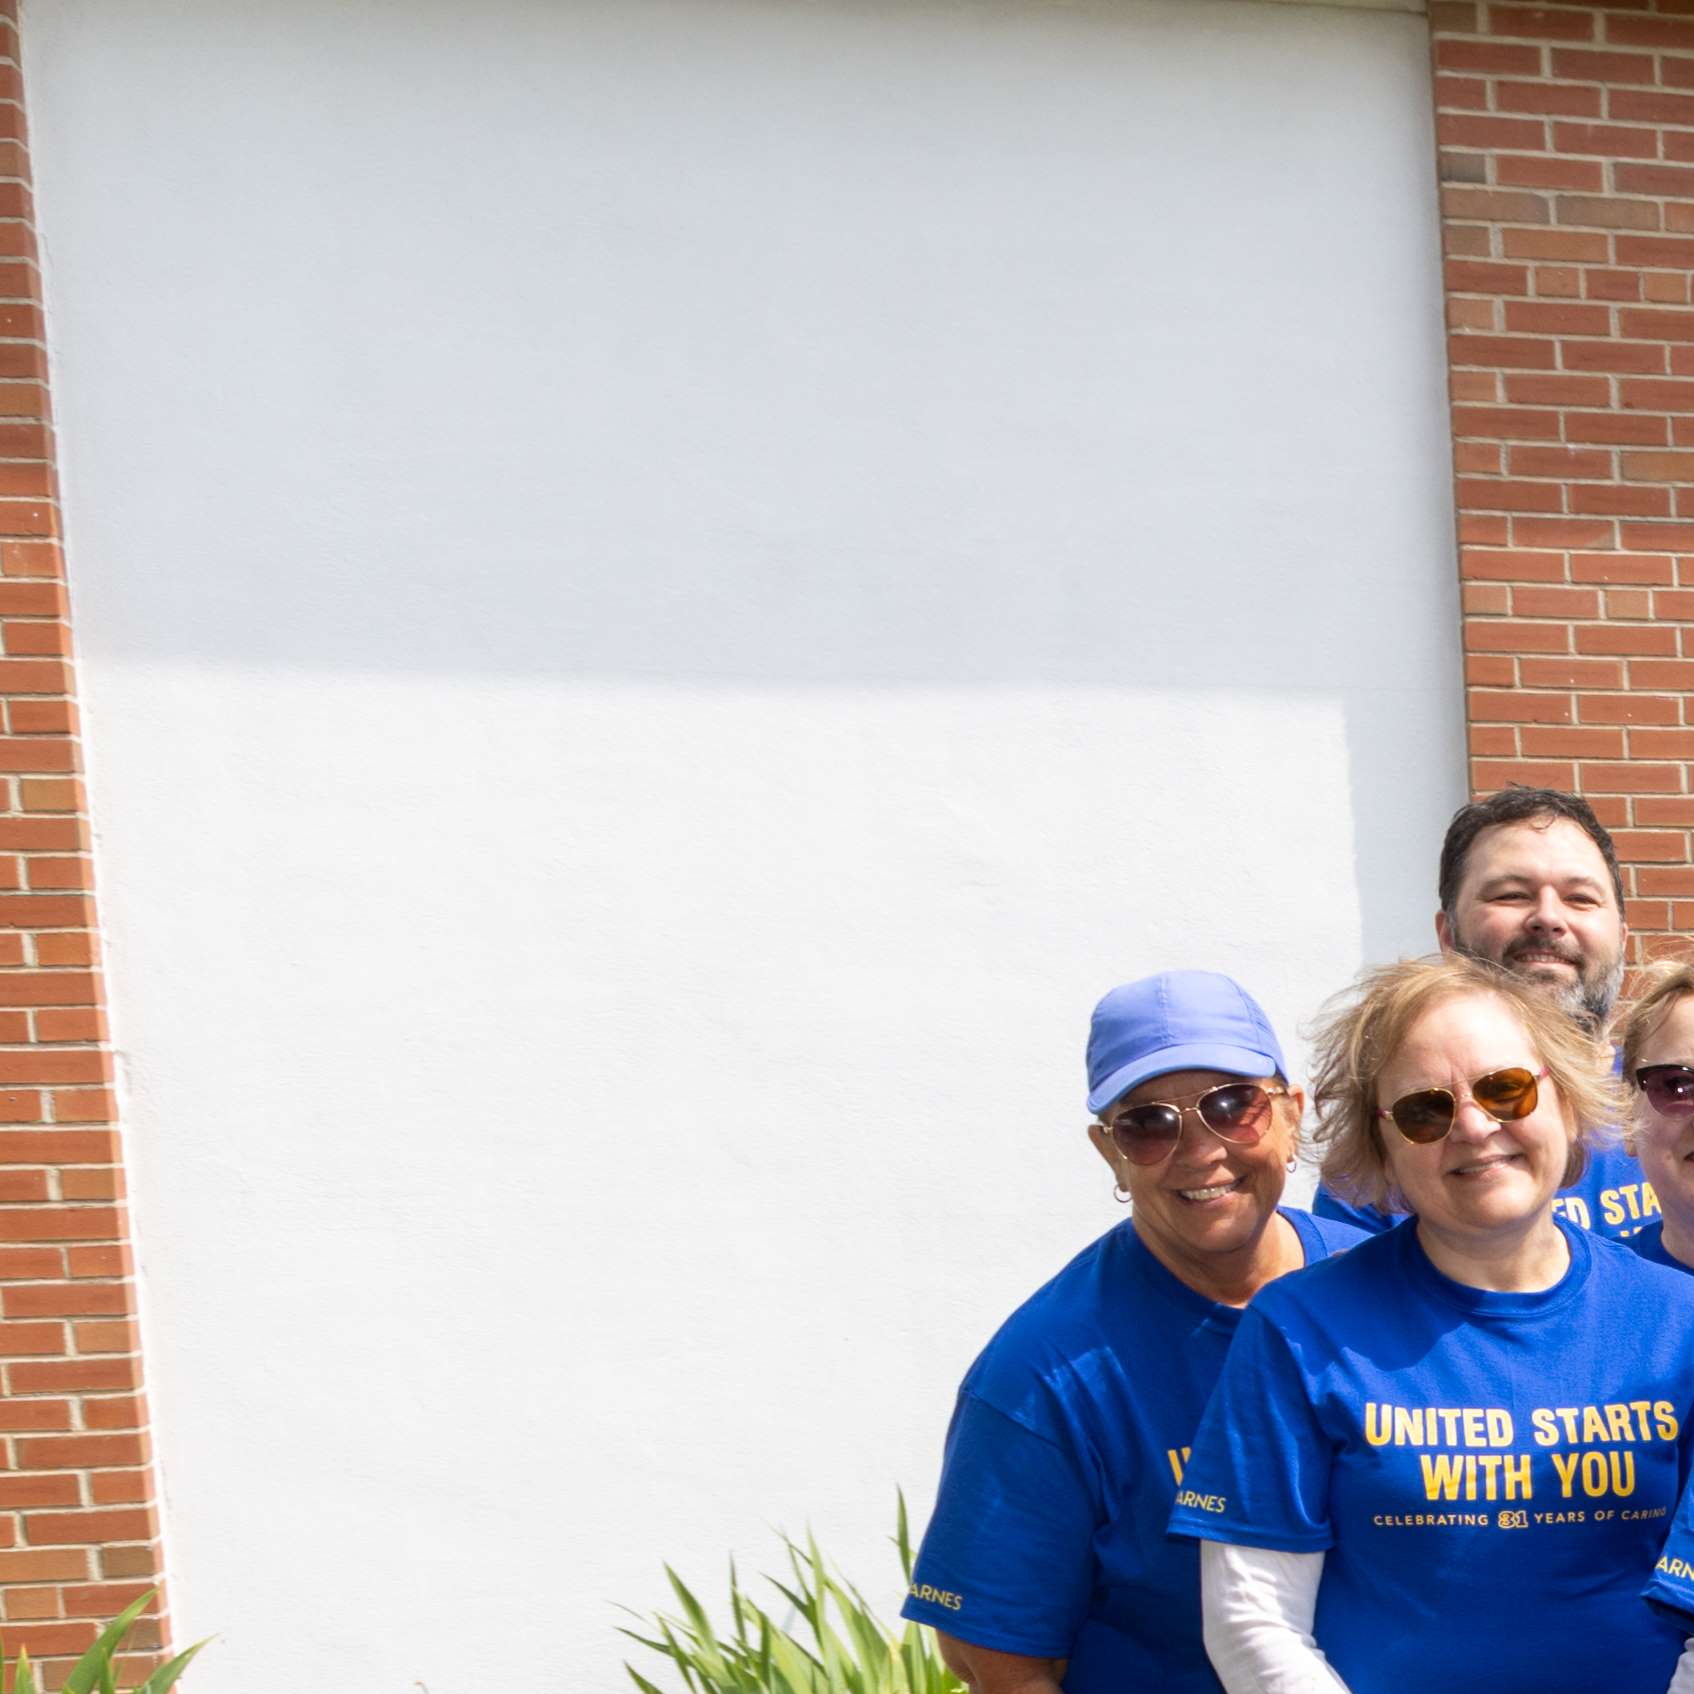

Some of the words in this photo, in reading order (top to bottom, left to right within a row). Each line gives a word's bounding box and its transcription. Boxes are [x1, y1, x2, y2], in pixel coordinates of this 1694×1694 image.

[1600, 1182, 1662, 1226] STA
[1364, 1402, 1513, 1447] UNITED
[1531, 1400, 1678, 1447] STARTS
[1420, 1454, 1532, 1501] WITH
[1551, 1450, 1636, 1498] YOU
[1176, 1489, 1227, 1514] ARNES
[1373, 1514, 1489, 1527] CELEBRATING
[1534, 1510, 1585, 1524] YEARS
[1594, 1510, 1614, 1522] OF
[909, 1582, 962, 1611] ARNES
